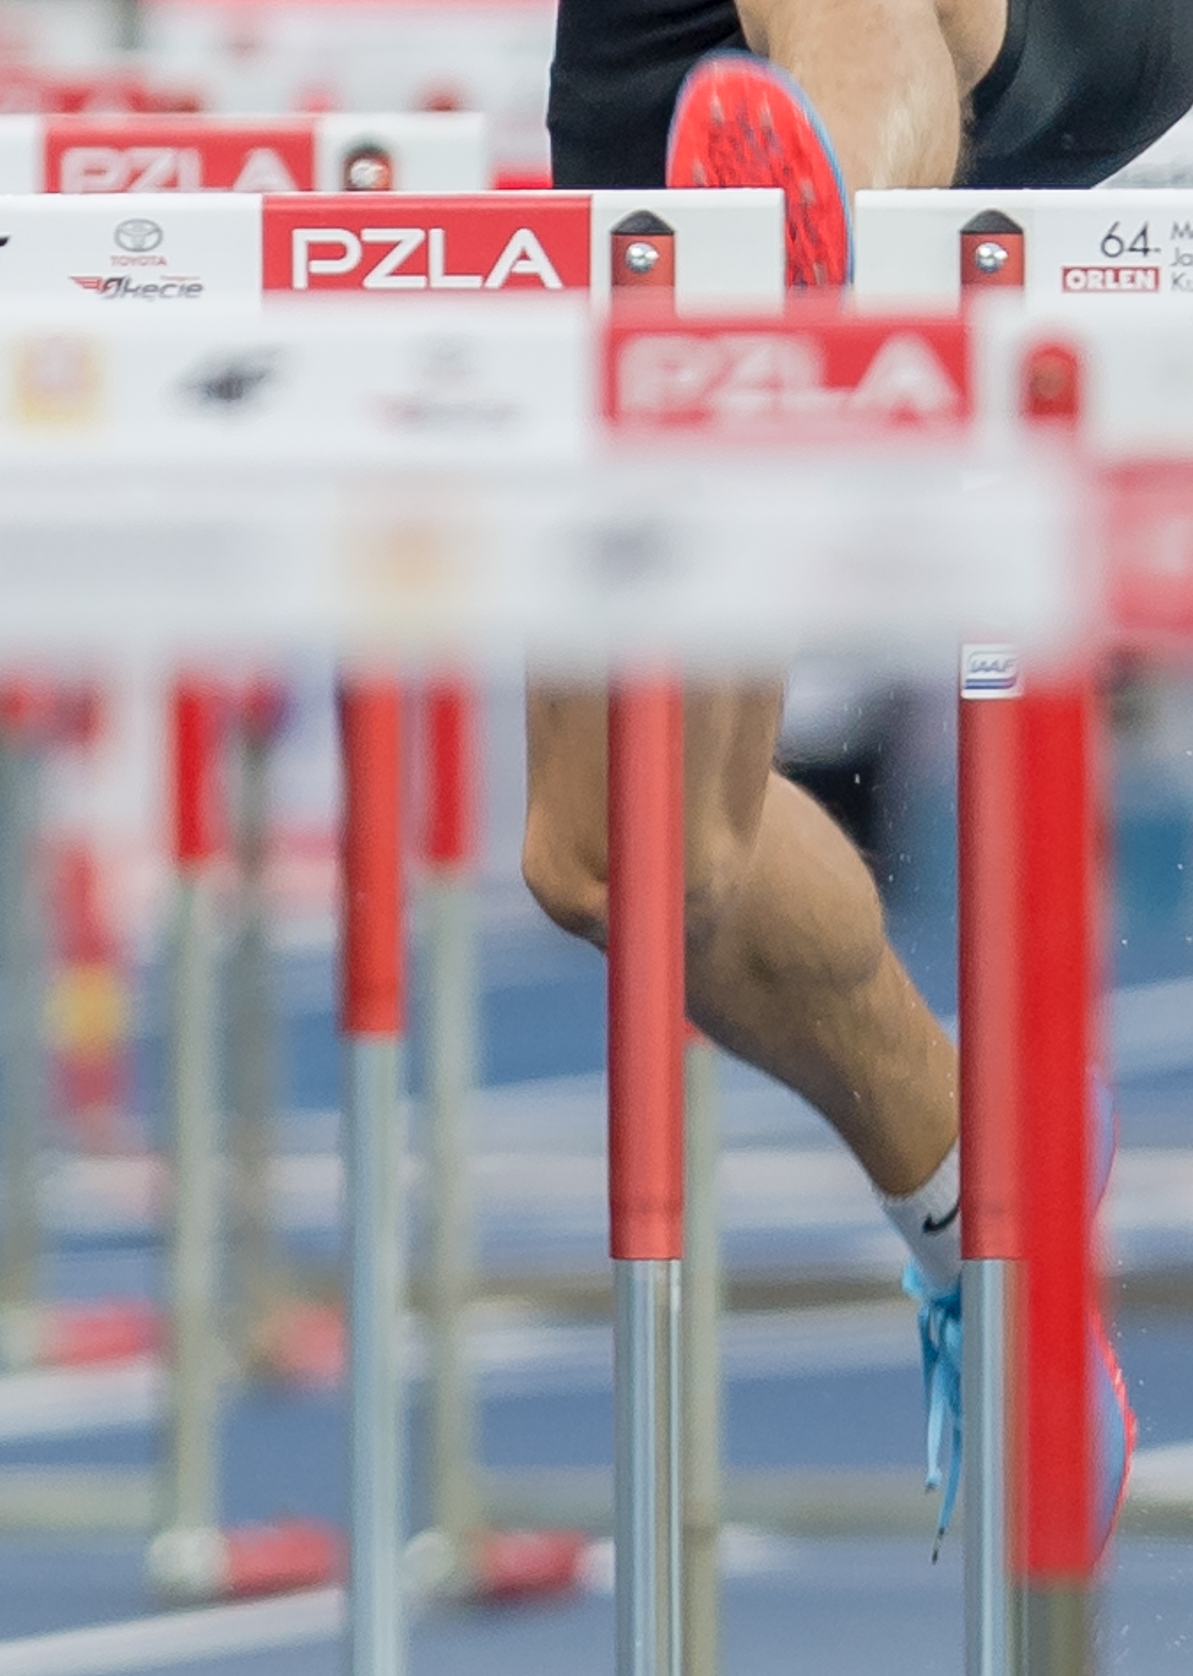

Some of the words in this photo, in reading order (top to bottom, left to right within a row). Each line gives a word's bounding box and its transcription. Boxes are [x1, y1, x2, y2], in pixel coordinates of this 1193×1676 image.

[109, 255, 168, 267] TOYOTA
[291, 228, 563, 290] PZLA
[1065, 269, 1156, 290] ORLEN
